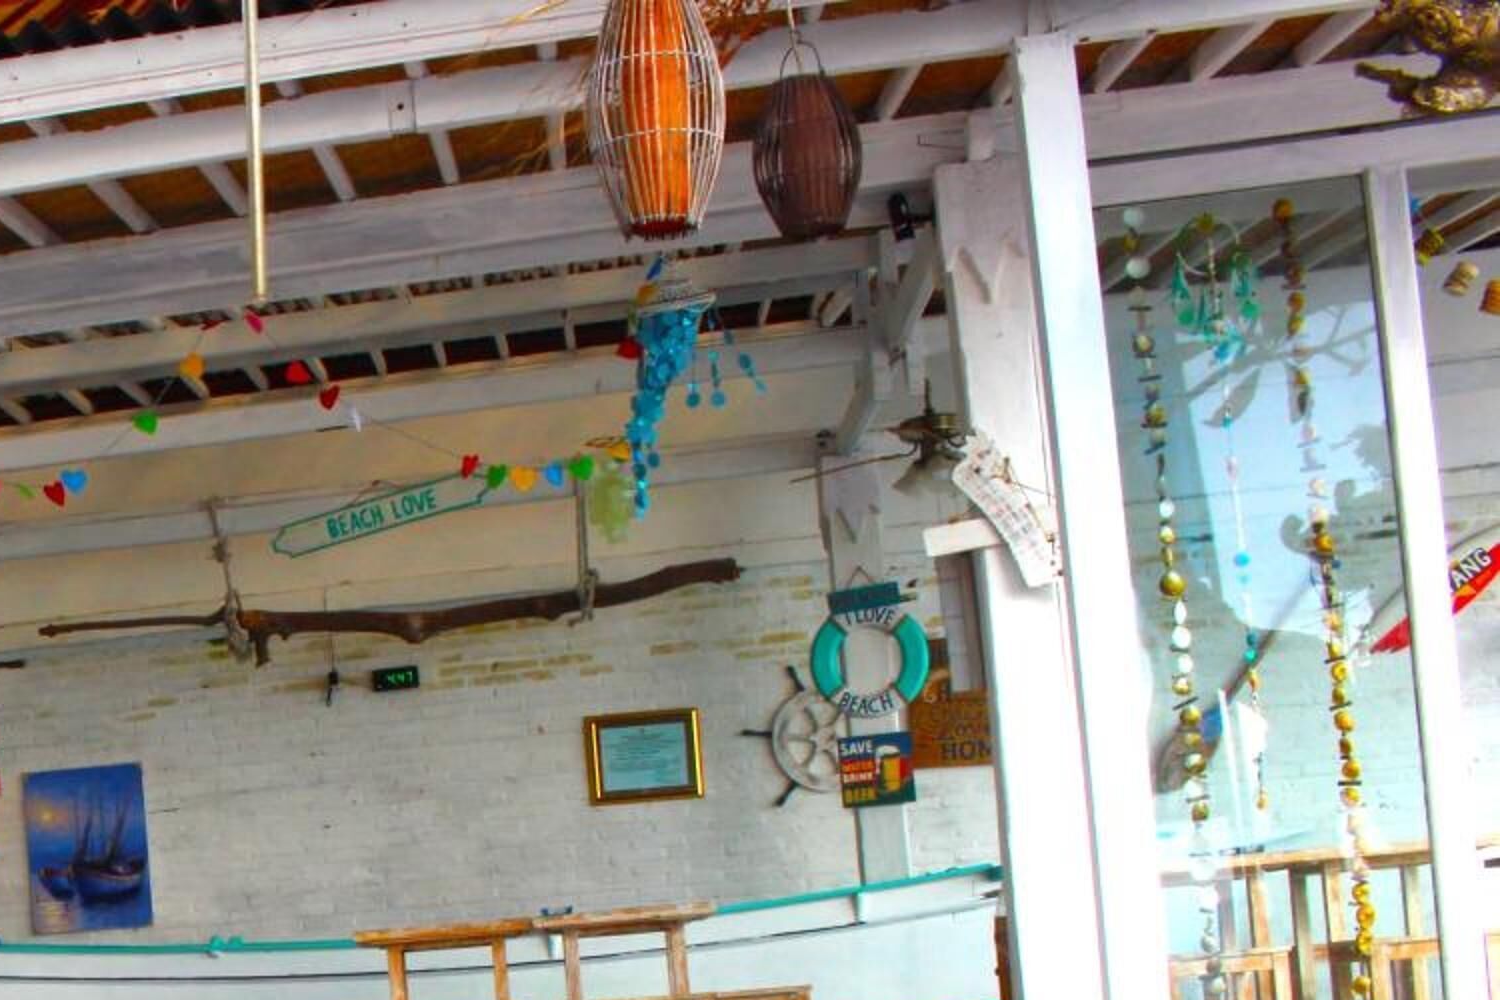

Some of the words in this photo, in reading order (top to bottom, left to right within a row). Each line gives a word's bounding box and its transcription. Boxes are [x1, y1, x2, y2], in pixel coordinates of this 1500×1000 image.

[326, 506, 384, 539] BEACH
[389, 488, 436, 519] LOVE
[855, 607, 896, 624] LOVE
[839, 691, 893, 713] BEACH
[841, 740, 873, 757] SAVE
